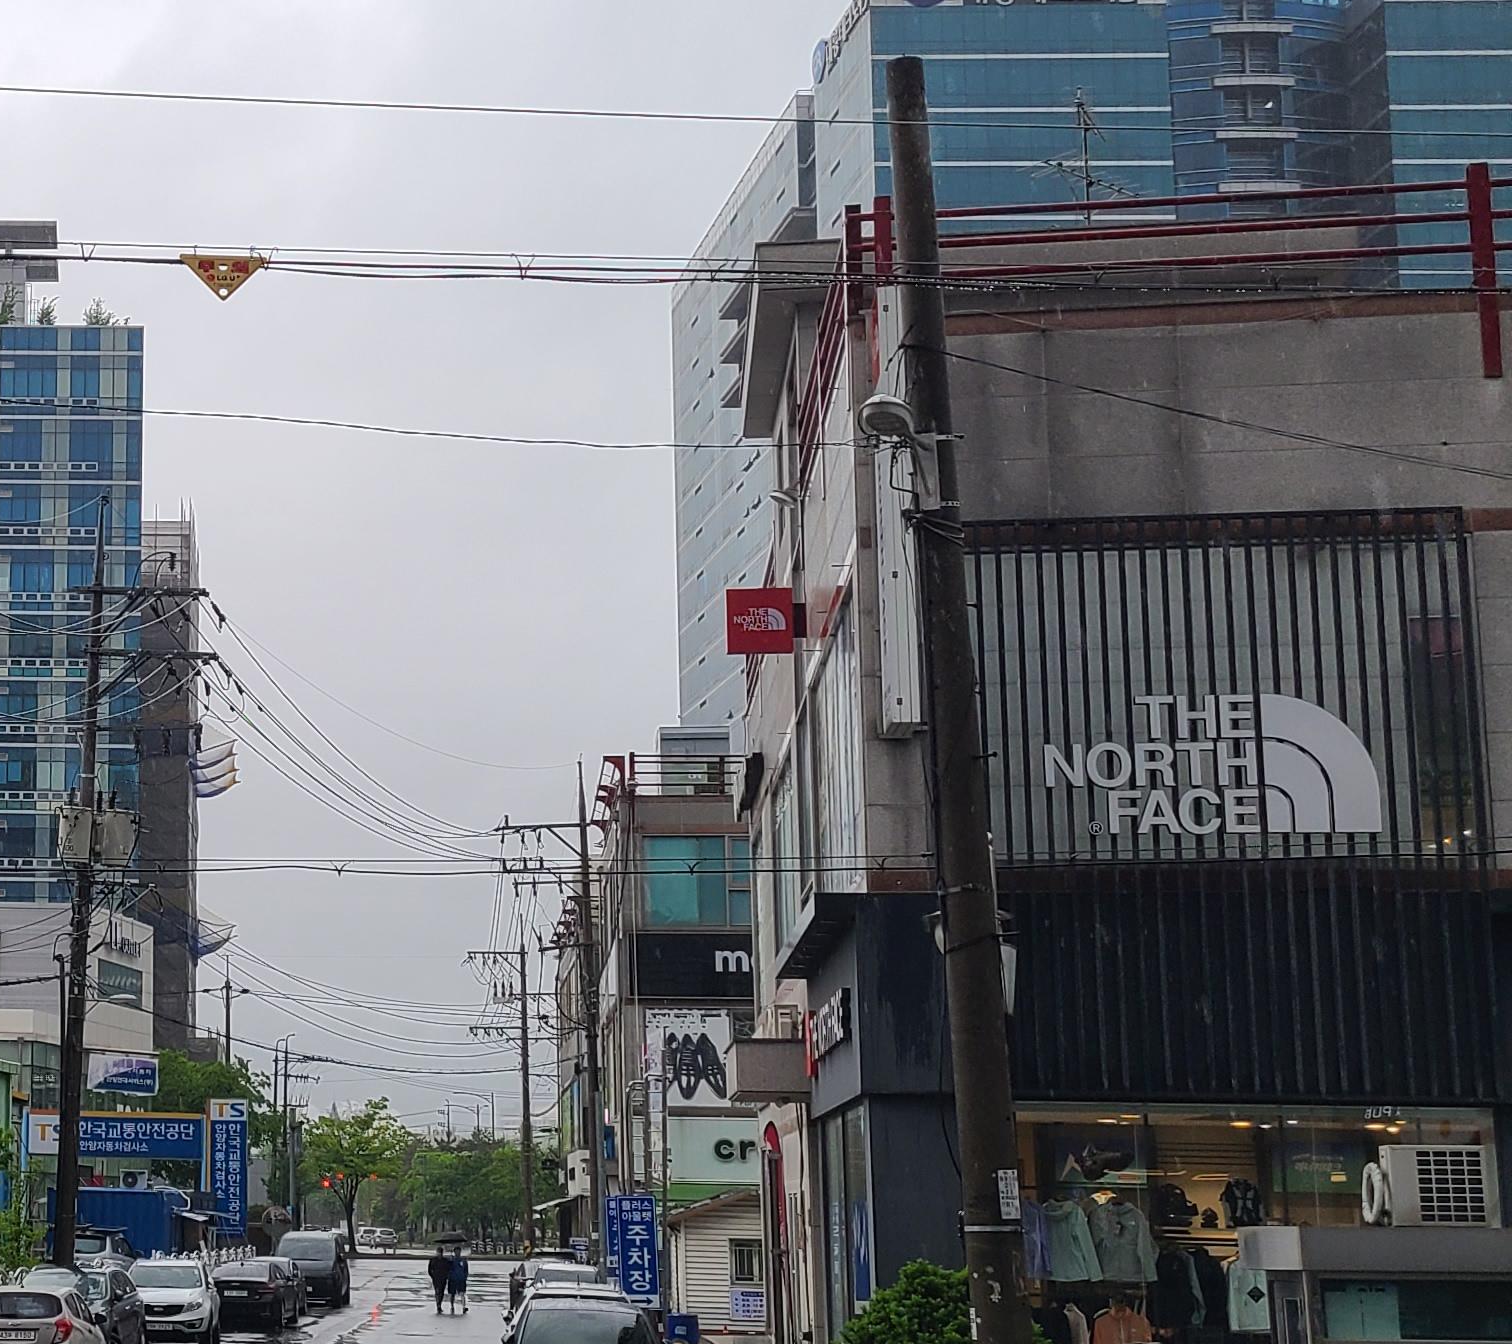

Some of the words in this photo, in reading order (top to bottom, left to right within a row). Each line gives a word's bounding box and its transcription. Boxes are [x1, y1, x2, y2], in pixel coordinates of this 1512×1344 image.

[733, 616, 768, 624] NORTH
[748, 607, 768, 616] THE
[743, 623, 769, 631] FACE
[1134, 694, 1256, 739] THE
[1043, 741, 1259, 788] NORTH
[1107, 788, 1261, 835] FACE
[715, 950, 755, 973] m
[212, 1103, 245, 1117] TS
[79, 1121, 195, 1140] 한국교통안전공단
[621, 1200, 652, 1211] 플러스
[626, 1225, 652, 1291] 주차장
